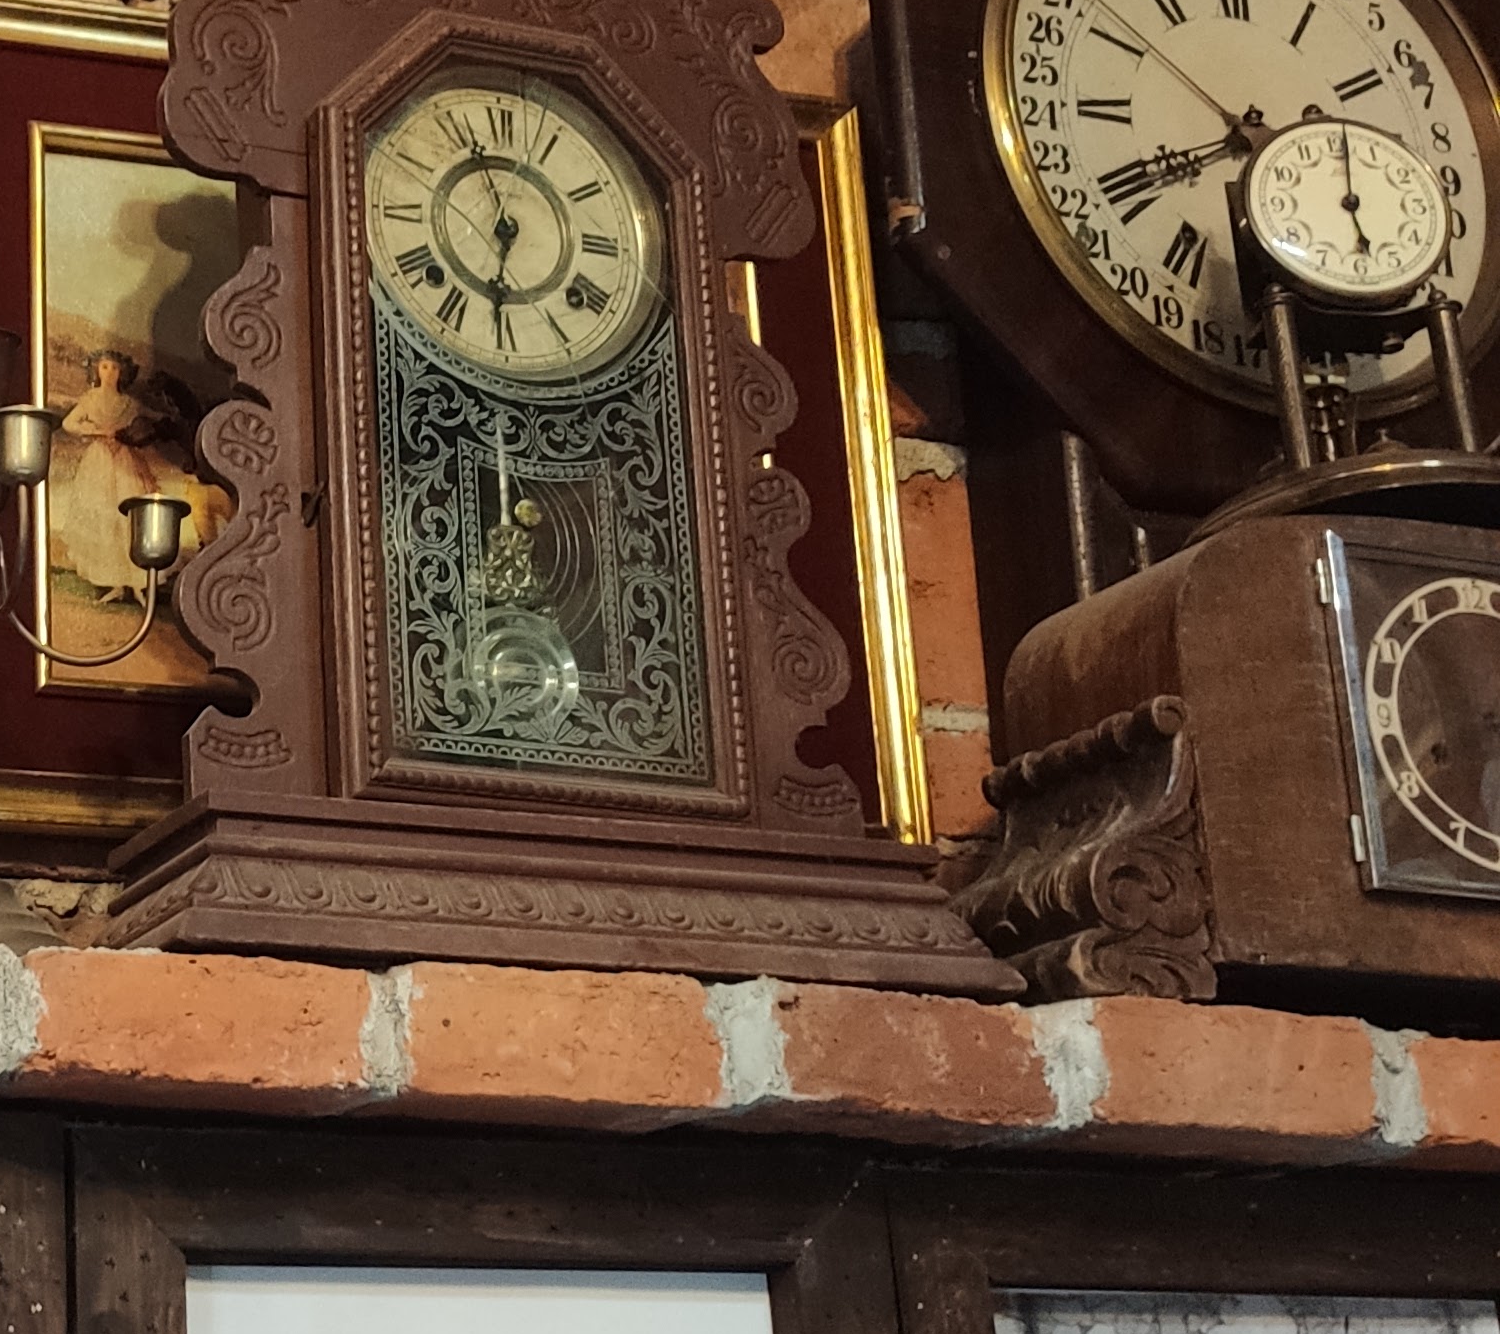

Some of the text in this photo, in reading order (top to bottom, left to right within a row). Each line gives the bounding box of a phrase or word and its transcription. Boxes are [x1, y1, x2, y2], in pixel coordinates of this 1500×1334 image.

[1026, 11, 1065, 47] 26
[1290, 1, 1317, 47] I
[1368, 2, 1386, 32] 5
[1394, 39, 1414, 67] 6
[1020, 52, 1059, 86] 25
[1332, 67, 1384, 103] II
[1418, 82, 1435, 110] 7
[1020, 95, 1057, 131] 24
[1076, 95, 1133, 127] IX
[485, 105, 514, 148] XII
[1431, 122, 1451, 153] 8
[539, 133, 558, 165] I
[1034, 140, 1071, 175] 23
[1297, 143, 1311, 161] 11
[1327, 136, 1344, 153] 12
[1369, 145, 1378, 161] 1
[1274, 166, 1293, 183] 10
[1397, 167, 1411, 185] 2
[1440, 165, 1461, 197] 9
[567, 180, 603, 203] II
[1051, 185, 1091, 220] 22
[1270, 196, 1285, 213] 9
[1412, 198, 1427, 215] 3
[582, 233, 619, 258] III
[1085, 227, 1112, 261] 21
[1286, 226, 1300, 244] 8
[1408, 228, 1423, 246] 4
[1163, 220, 1208, 289] VII
[1316, 249, 1328, 267] 7
[1354, 258, 1368, 275] 6
[1388, 251, 1401, 269] 5
[1110, 263, 1149, 301] 20
[435, 284, 469, 333] VII
[1153, 295, 1184, 330] 19
[1191, 319, 1225, 355] 18
[1461, 583, 1486, 610] 12
[1380, 637, 1401, 664] 10
[1377, 702, 1391, 729] 9
[1400, 770, 1420, 799] 8
[1449, 821, 1466, 849] 7
